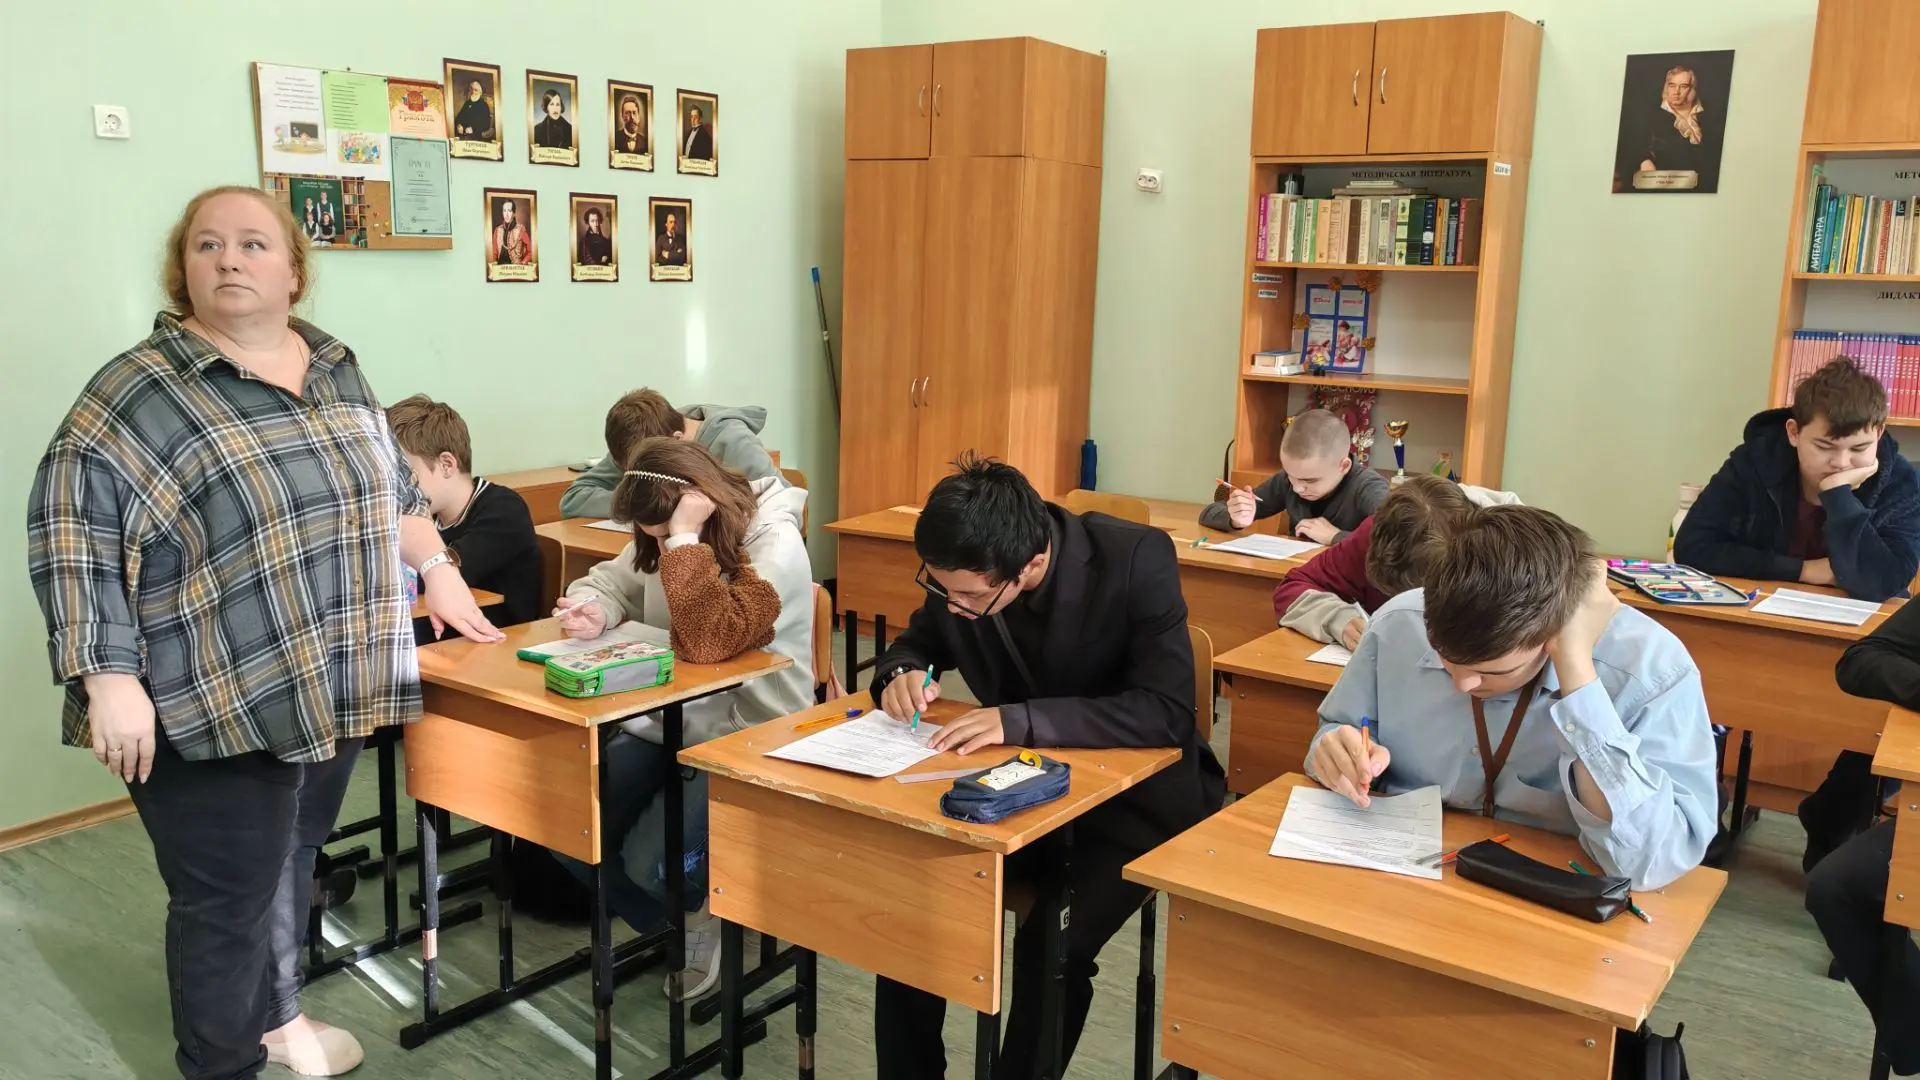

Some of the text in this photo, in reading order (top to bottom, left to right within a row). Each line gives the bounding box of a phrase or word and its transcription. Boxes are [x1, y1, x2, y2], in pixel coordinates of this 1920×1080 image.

[1420, 169, 1472, 178] ЛИТЕРАТУРА
[1810, 216, 1825, 270] ЛИТЕРАТУРА
[1063, 911, 1069, 925] 6
